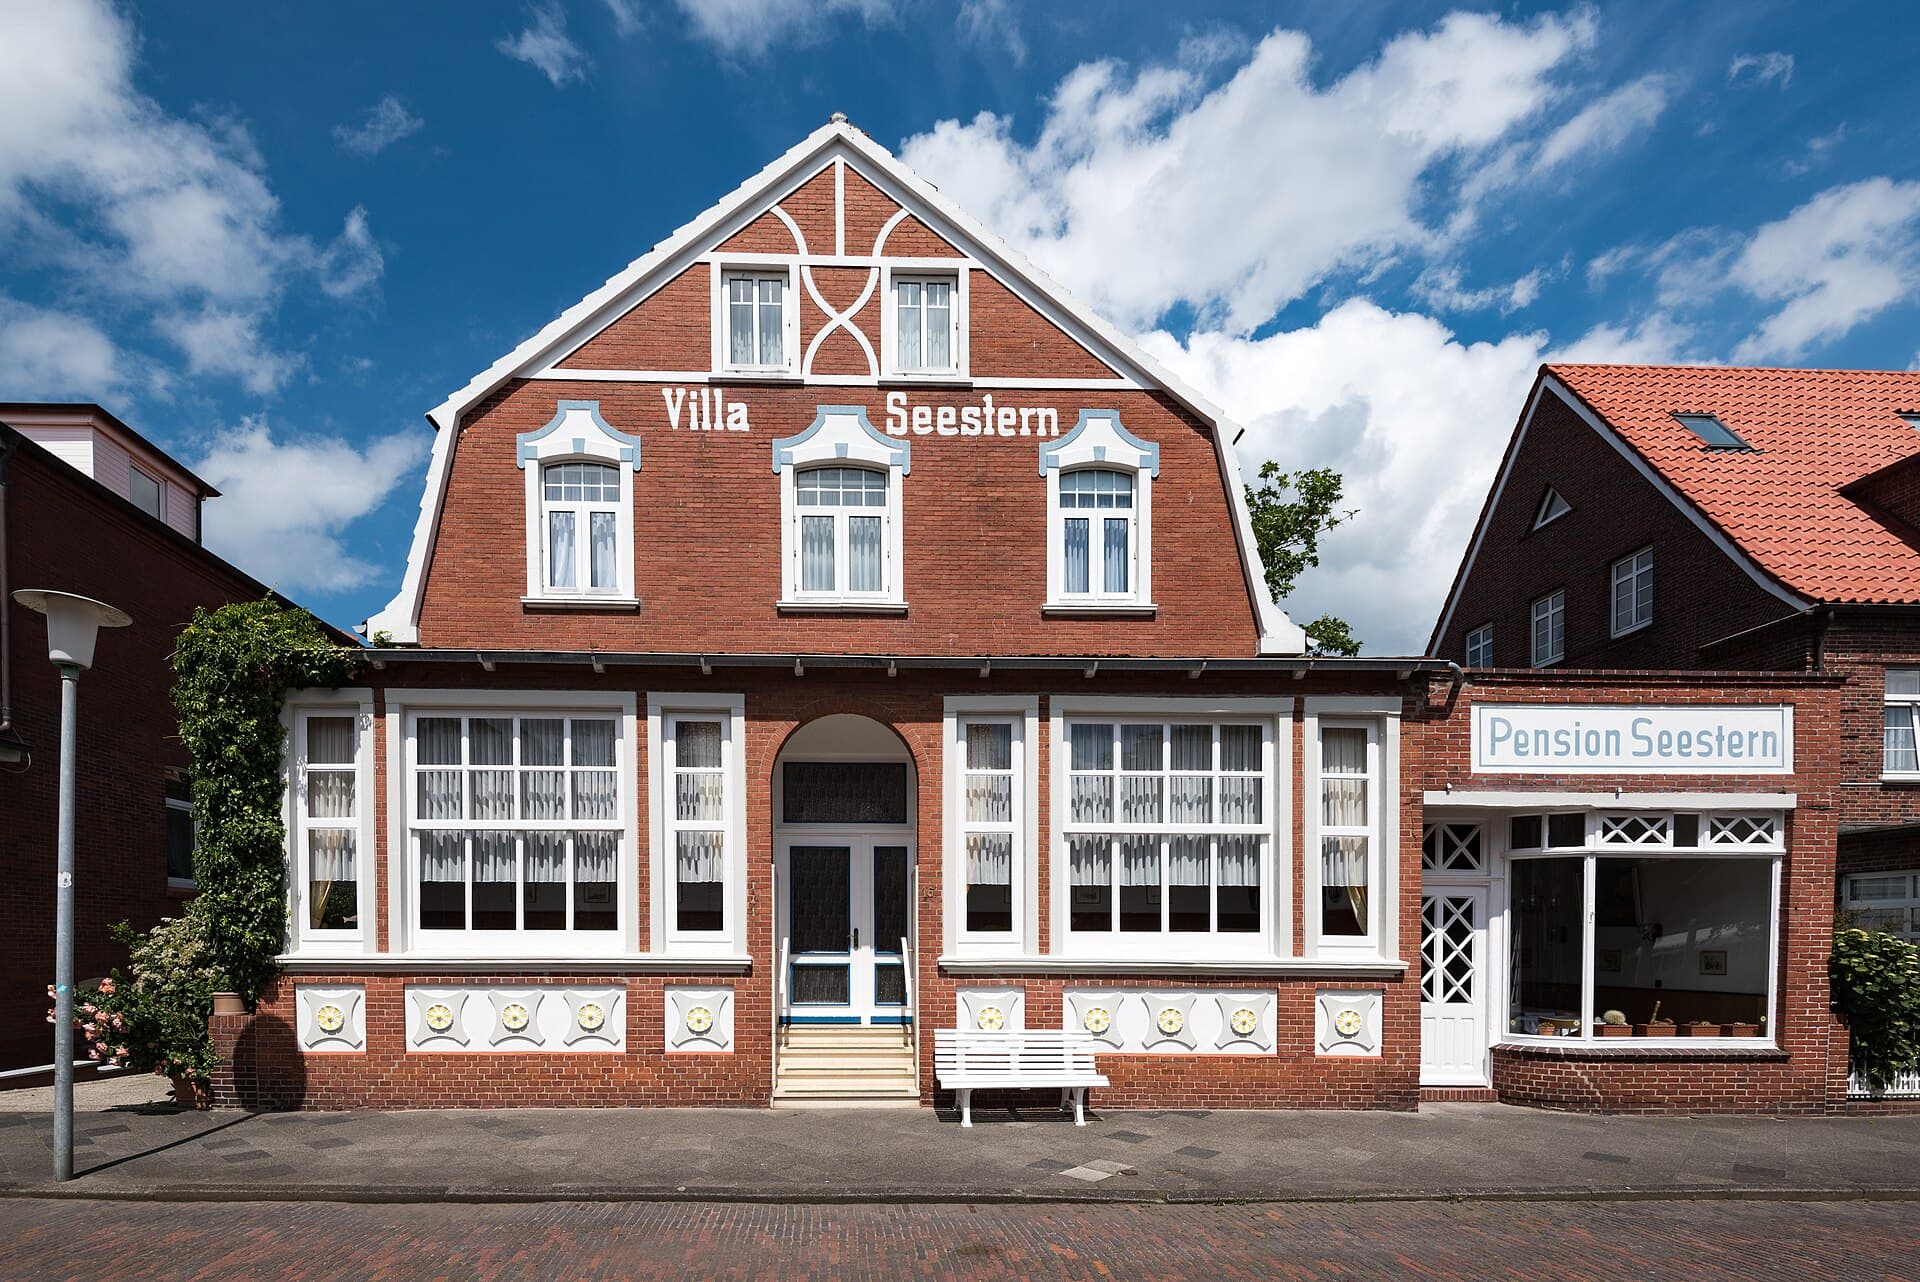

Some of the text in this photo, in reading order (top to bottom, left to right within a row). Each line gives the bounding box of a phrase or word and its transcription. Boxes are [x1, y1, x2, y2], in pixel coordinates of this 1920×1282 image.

[662, 387, 1060, 437] Villa Seestern
[1490, 717, 1778, 758] Pension Seestern
